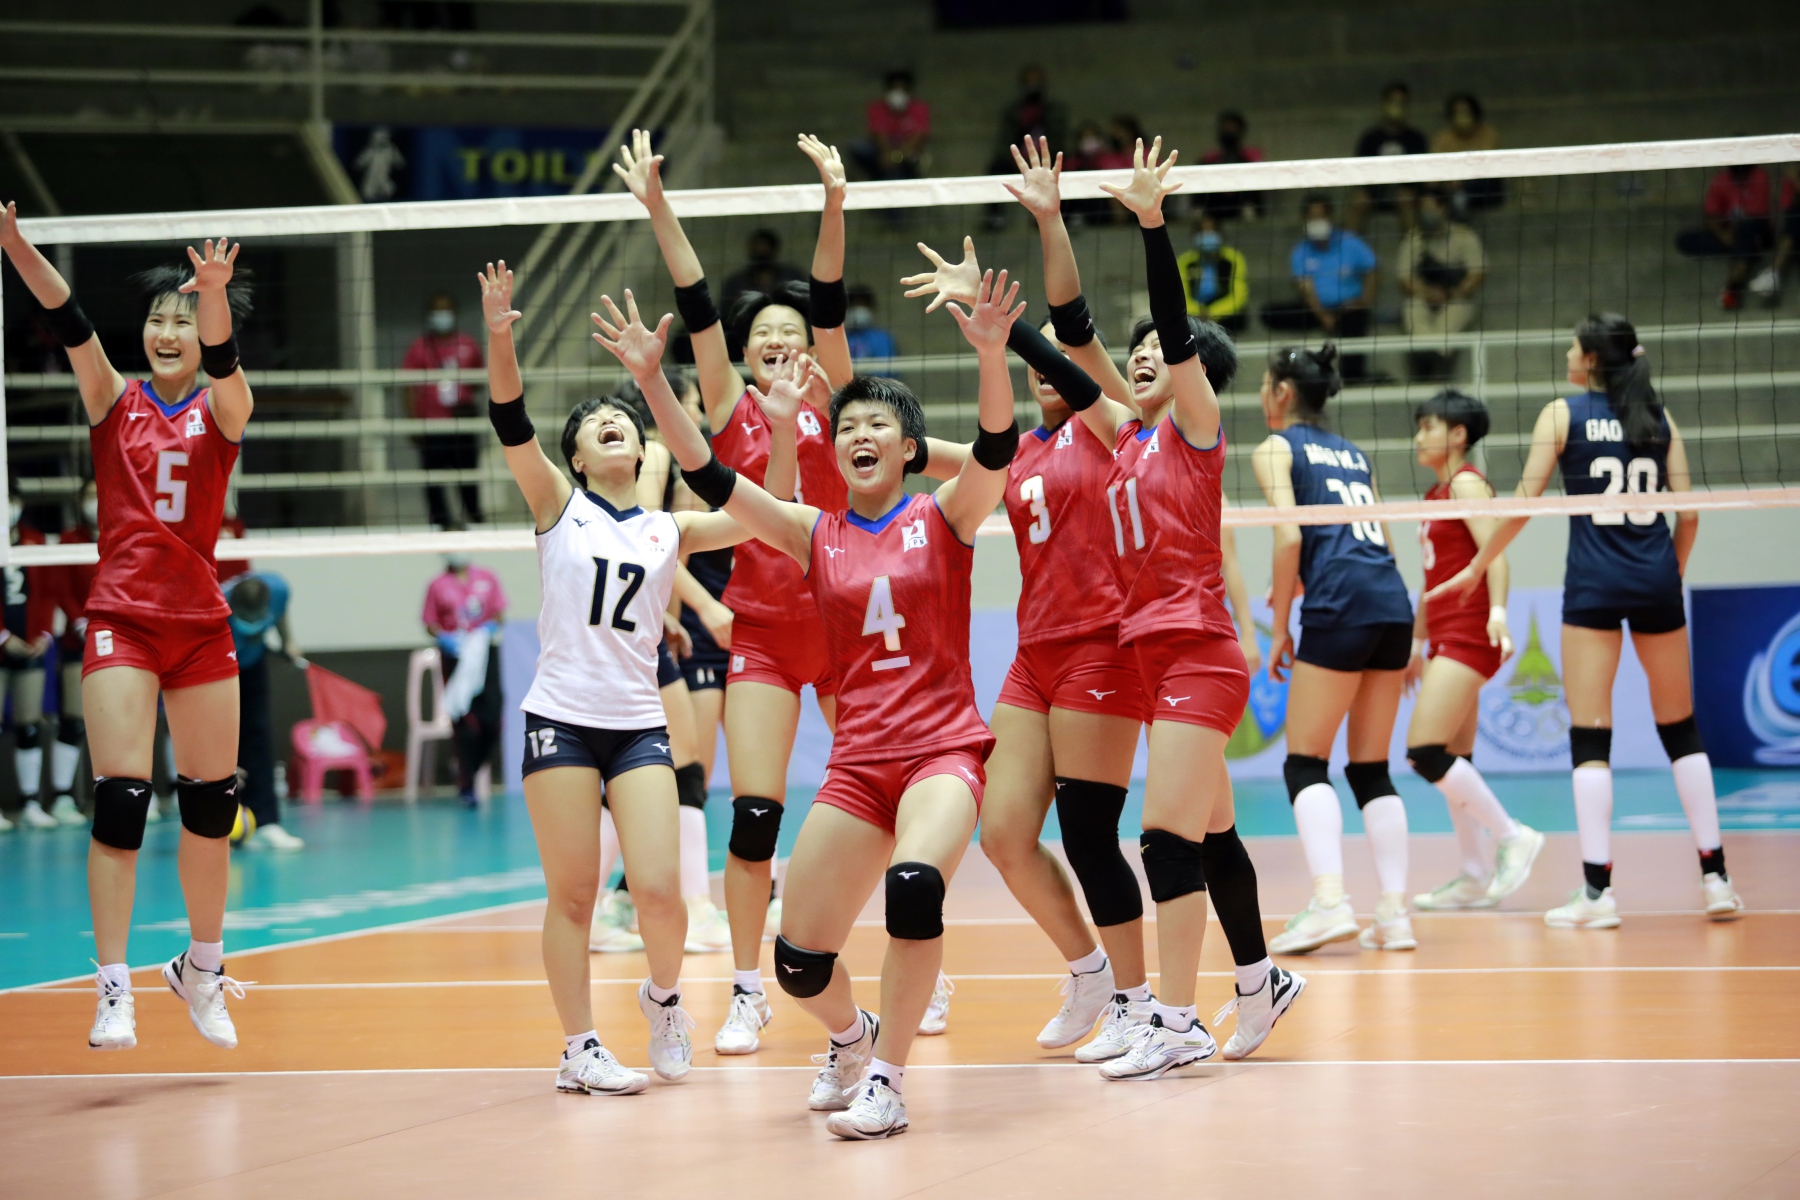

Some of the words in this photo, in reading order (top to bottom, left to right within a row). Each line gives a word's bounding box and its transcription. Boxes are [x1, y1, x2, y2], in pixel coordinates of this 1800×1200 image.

[1585, 419, 1623, 442] GAO
[154, 450, 189, 522] 5
[1020, 475, 1051, 544] 3
[1107, 477, 1146, 557] 11
[1589, 456, 1659, 526] 20
[906, 538, 925, 549] JPN
[588, 555, 646, 634] 12
[861, 575, 906, 651] 4
[95, 630, 114, 656] 5
[528, 727, 558, 758] 12
